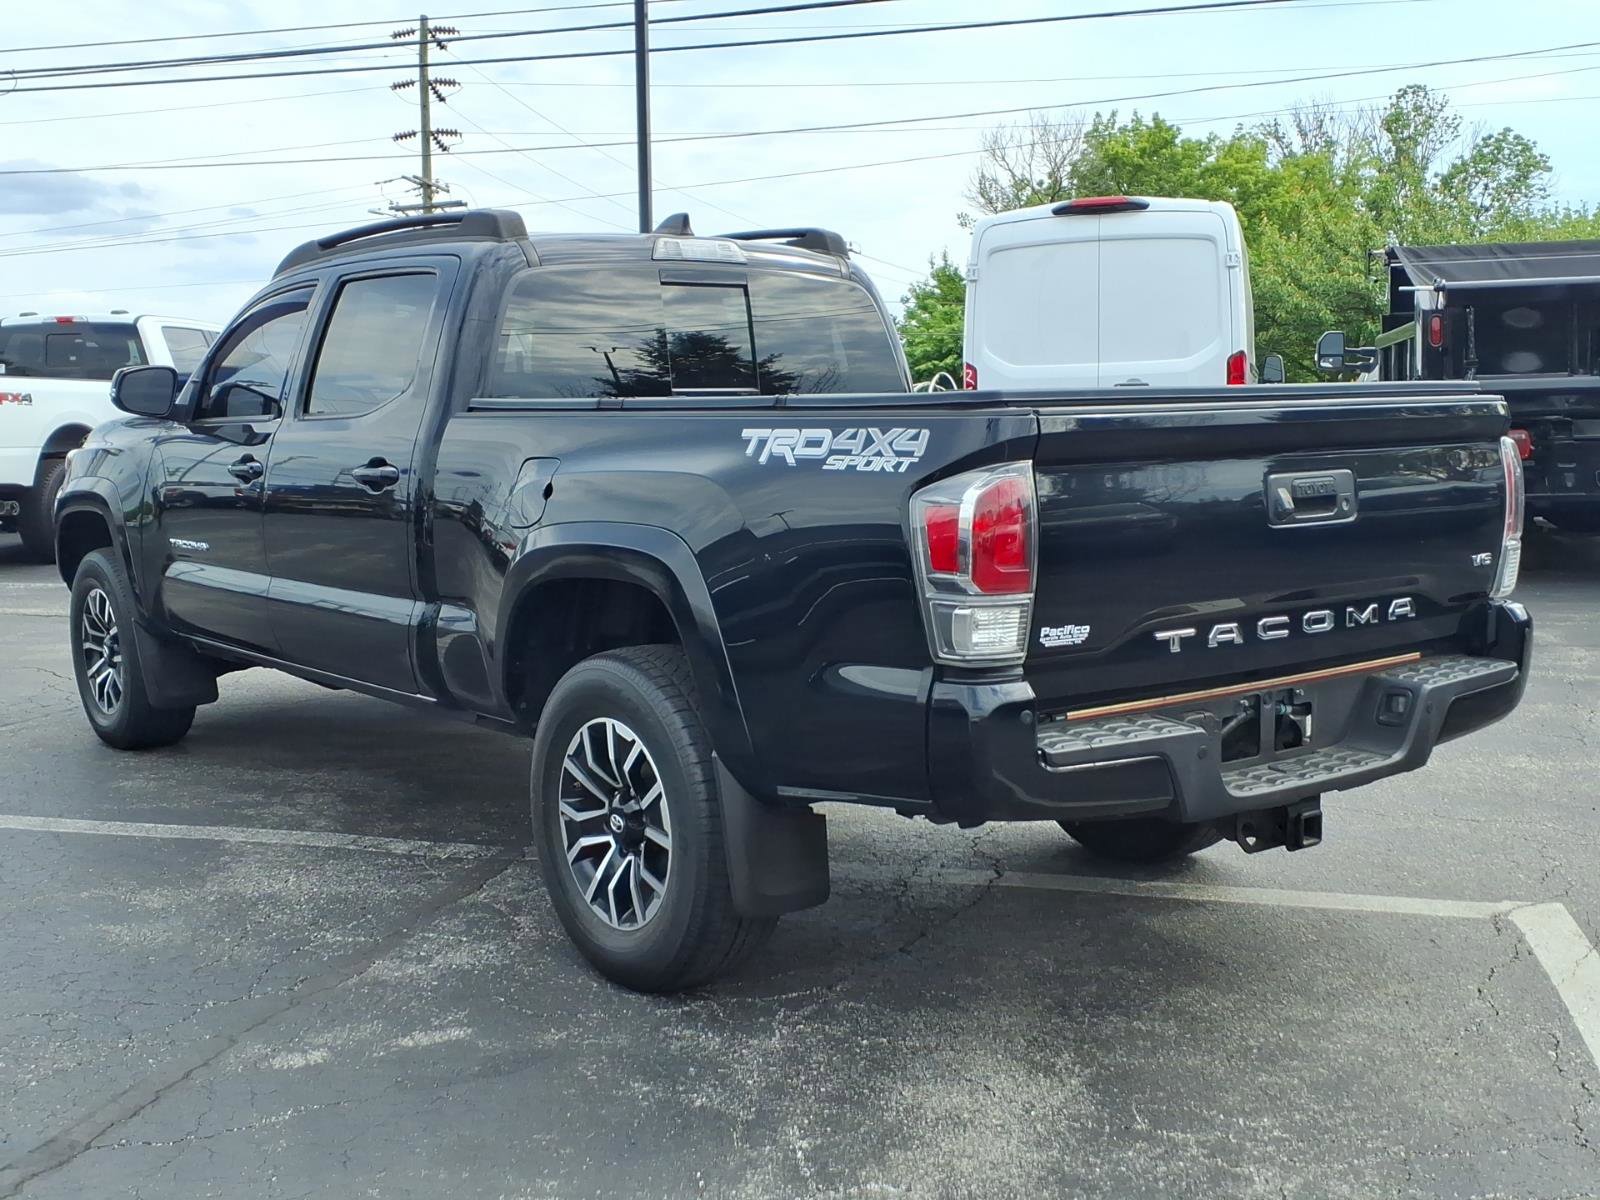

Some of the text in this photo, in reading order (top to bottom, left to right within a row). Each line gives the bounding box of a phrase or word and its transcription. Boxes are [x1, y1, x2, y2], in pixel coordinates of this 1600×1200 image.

[822, 455, 919, 473] SPORT
[1040, 624, 1090, 637] Pacifico
[1153, 597, 1416, 653] TACOMA
